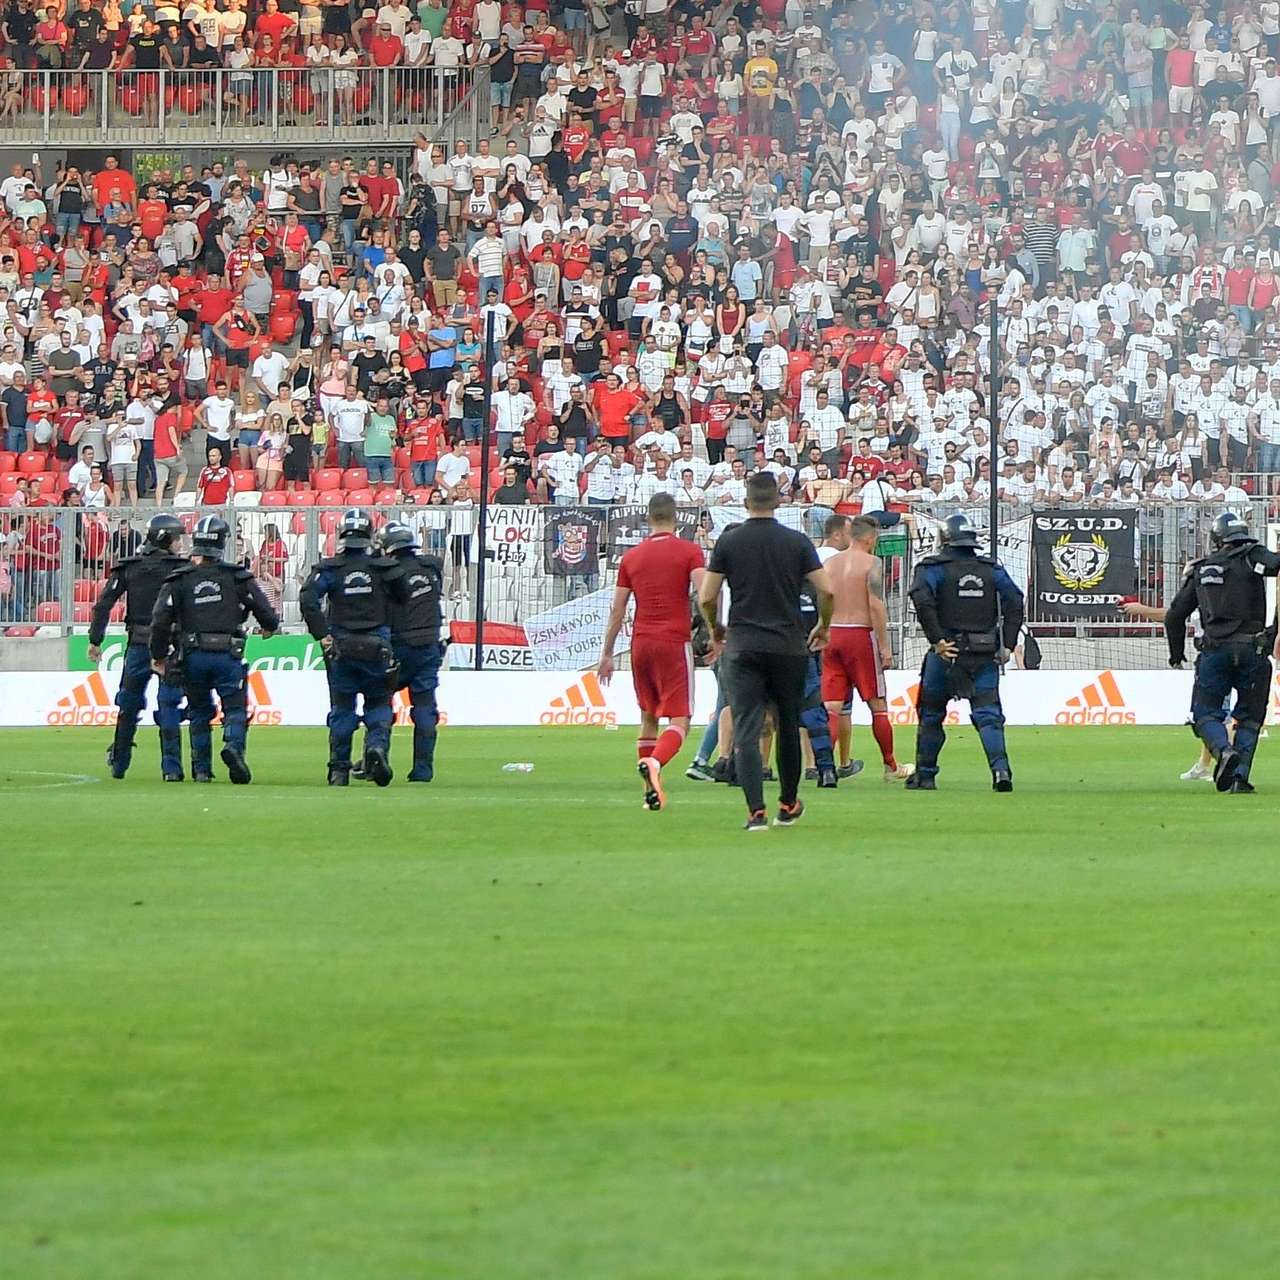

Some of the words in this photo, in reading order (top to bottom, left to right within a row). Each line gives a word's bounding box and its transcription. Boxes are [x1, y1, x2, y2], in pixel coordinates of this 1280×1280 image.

[1036, 518, 1128, 531] SZ.U.D.
[539, 702, 617, 726] adidas
[1055, 703, 1136, 726] adidas
